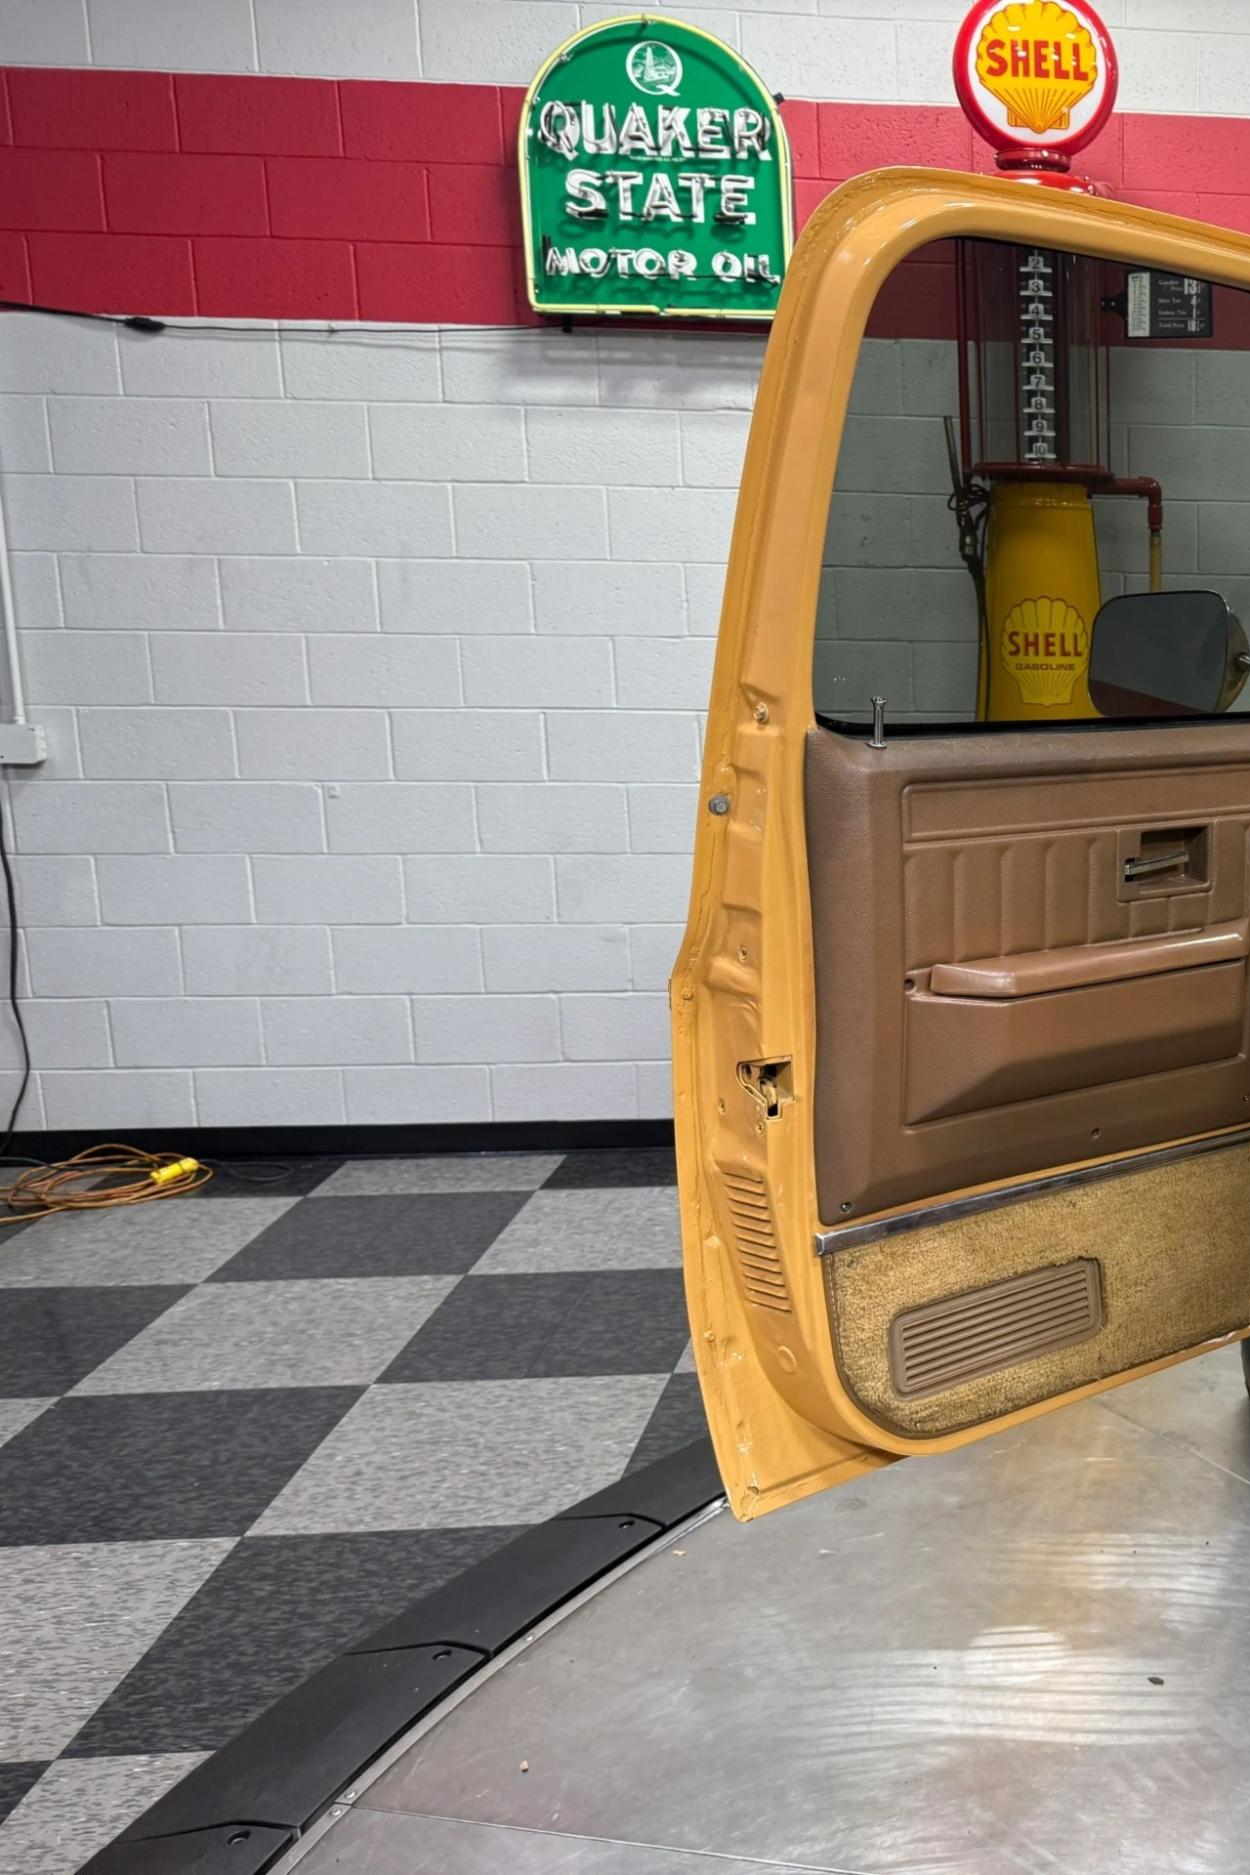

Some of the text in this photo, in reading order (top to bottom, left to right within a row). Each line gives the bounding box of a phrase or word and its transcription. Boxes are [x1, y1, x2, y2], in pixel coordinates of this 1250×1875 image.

[986, 38, 1089, 82] SHELL
[538, 100, 773, 161] QUAKER
[565, 168, 756, 225] STATE
[545, 247, 781, 286] MOTOR OIL
[1031, 257, 1041, 269] 2
[1031, 281, 1041, 293] 3
[1031, 305, 1041, 316] 4
[1032, 328, 1042, 340] 5
[1032, 352, 1042, 364] 6
[1033, 376, 1042, 387] 7
[1034, 398, 1044, 410] 8
[1035, 421, 1044, 432] 9
[1035, 445, 1046, 456] 10
[1008, 630, 1083, 657] SHELL
[1015, 662, 1076, 672] GASOLINE
